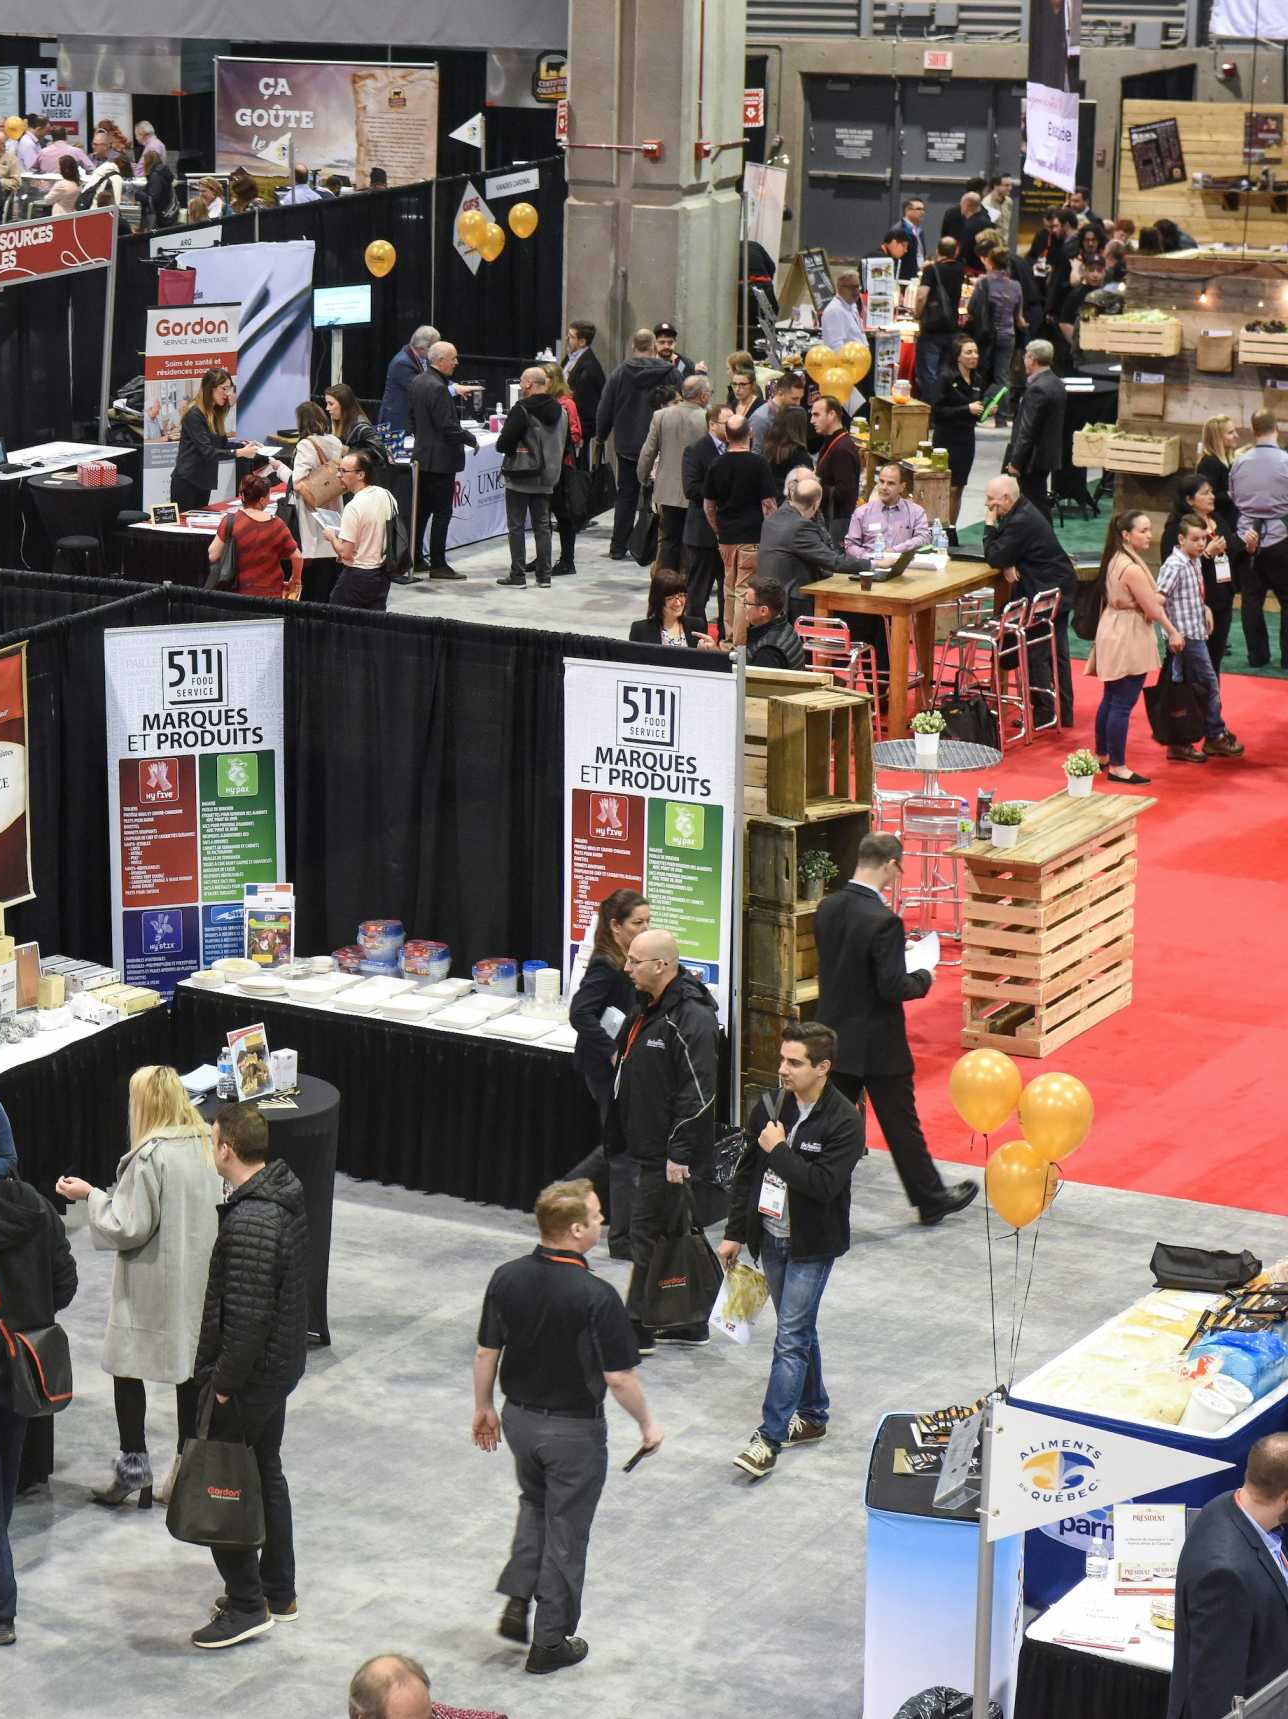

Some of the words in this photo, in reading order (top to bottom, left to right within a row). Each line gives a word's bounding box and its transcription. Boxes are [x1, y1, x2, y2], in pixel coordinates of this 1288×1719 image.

[259, 77, 292, 99] ÇA
[41, 93, 72, 108] VEAU
[235, 105, 314, 129] GOÛTE
[155, 317, 229, 337] Gordon
[162, 338, 188, 346] SERVICE
[190, 336, 229, 345] ALIMENTAIRE
[156, 368, 193, 376] résidences
[164, 360, 182, 368] Soins
[184, 359, 194, 367] de
[168, 648, 213, 688] 511
[191, 676, 214, 686] FOOD
[176, 687, 214, 698] SERVICE
[622, 685, 666, 724] 511
[142, 708, 249, 732] MARQUES
[644, 716, 666, 727] FOOD
[127, 733, 151, 752] ET
[157, 727, 264, 750] PRODUITS
[629, 727, 666, 739] SERVICE
[595, 746, 698, 775] MARQUES
[581, 765, 603, 785] ET
[608, 769, 712, 797] PRODUITS
[1019, 1439, 1102, 1461] ALIMENTS
[1031, 1482, 1099, 1503] QUÉBEC
